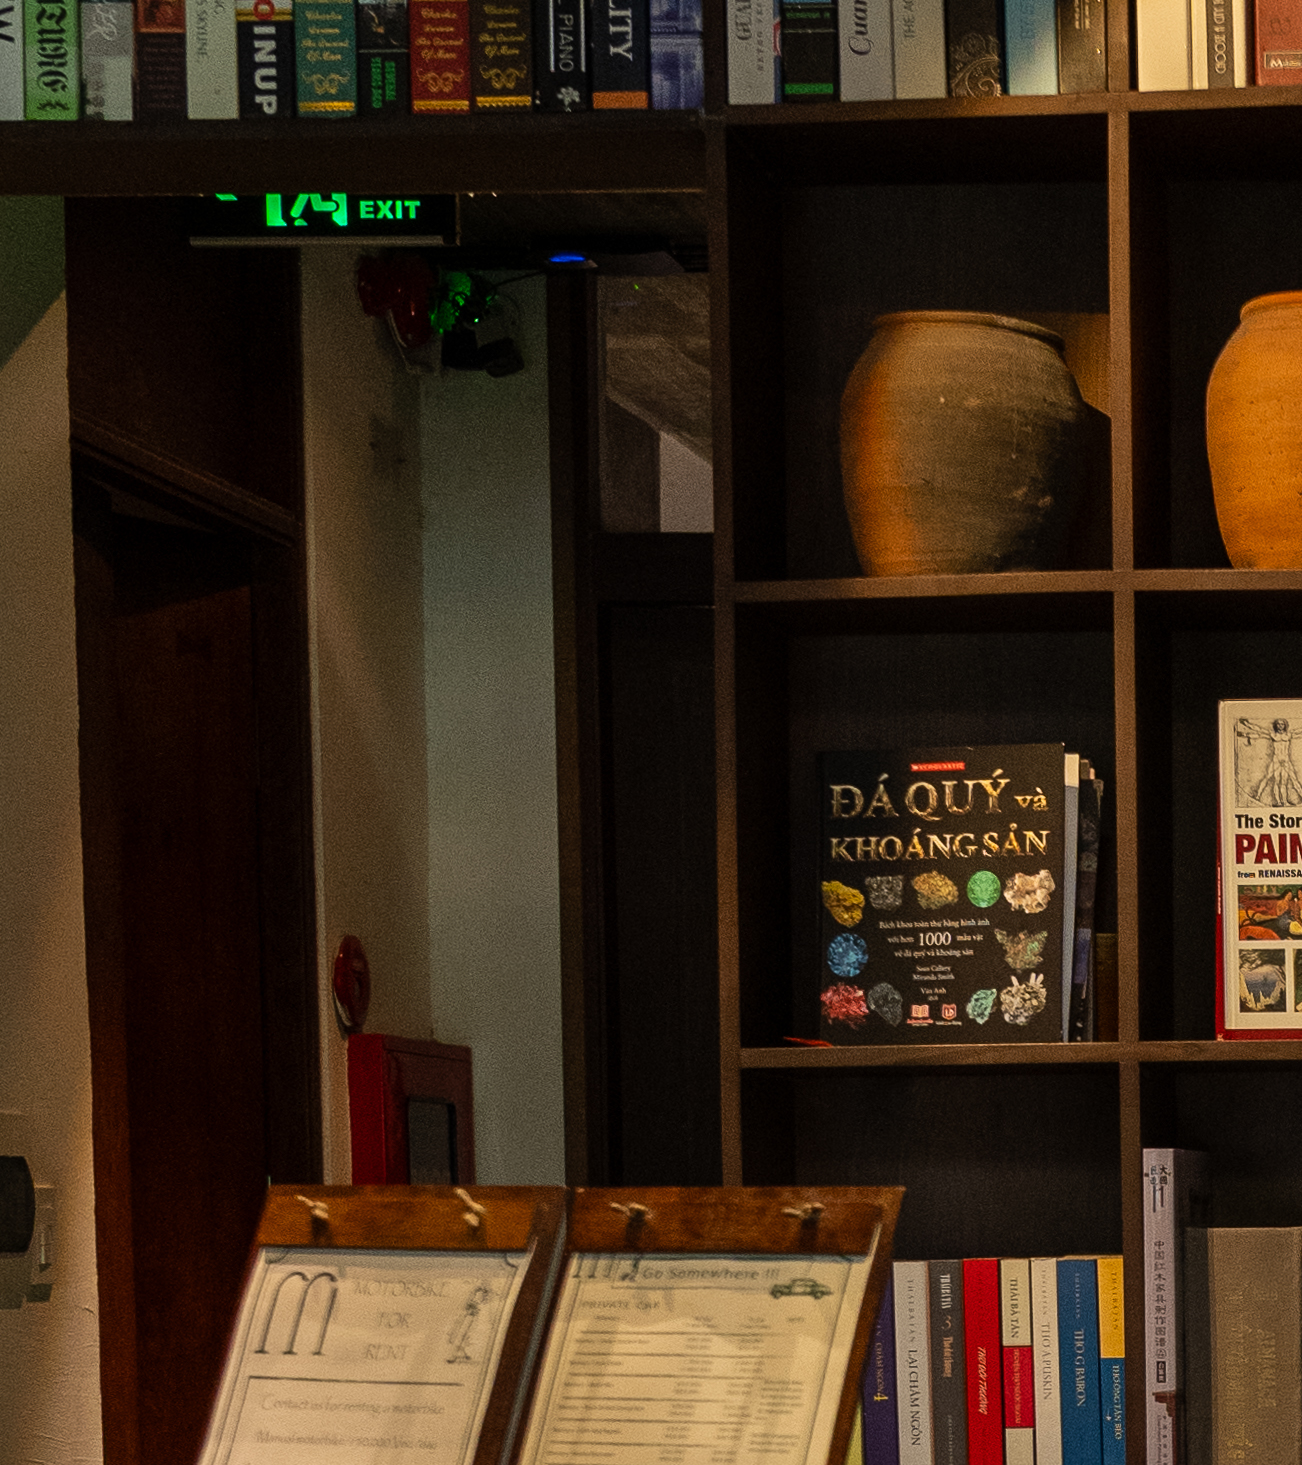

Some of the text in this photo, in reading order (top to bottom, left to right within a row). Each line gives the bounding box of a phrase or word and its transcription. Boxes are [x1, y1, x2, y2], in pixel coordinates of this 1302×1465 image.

[555, 13, 577, 73] PIANO
[359, 200, 421, 220] EXIT
[829, 768, 1050, 823] ĐÁ QUÝ và
[1235, 815, 1264, 829] The
[829, 822, 1051, 863] KHOÁNG SẢN
[918, 932, 953, 947] 1000
